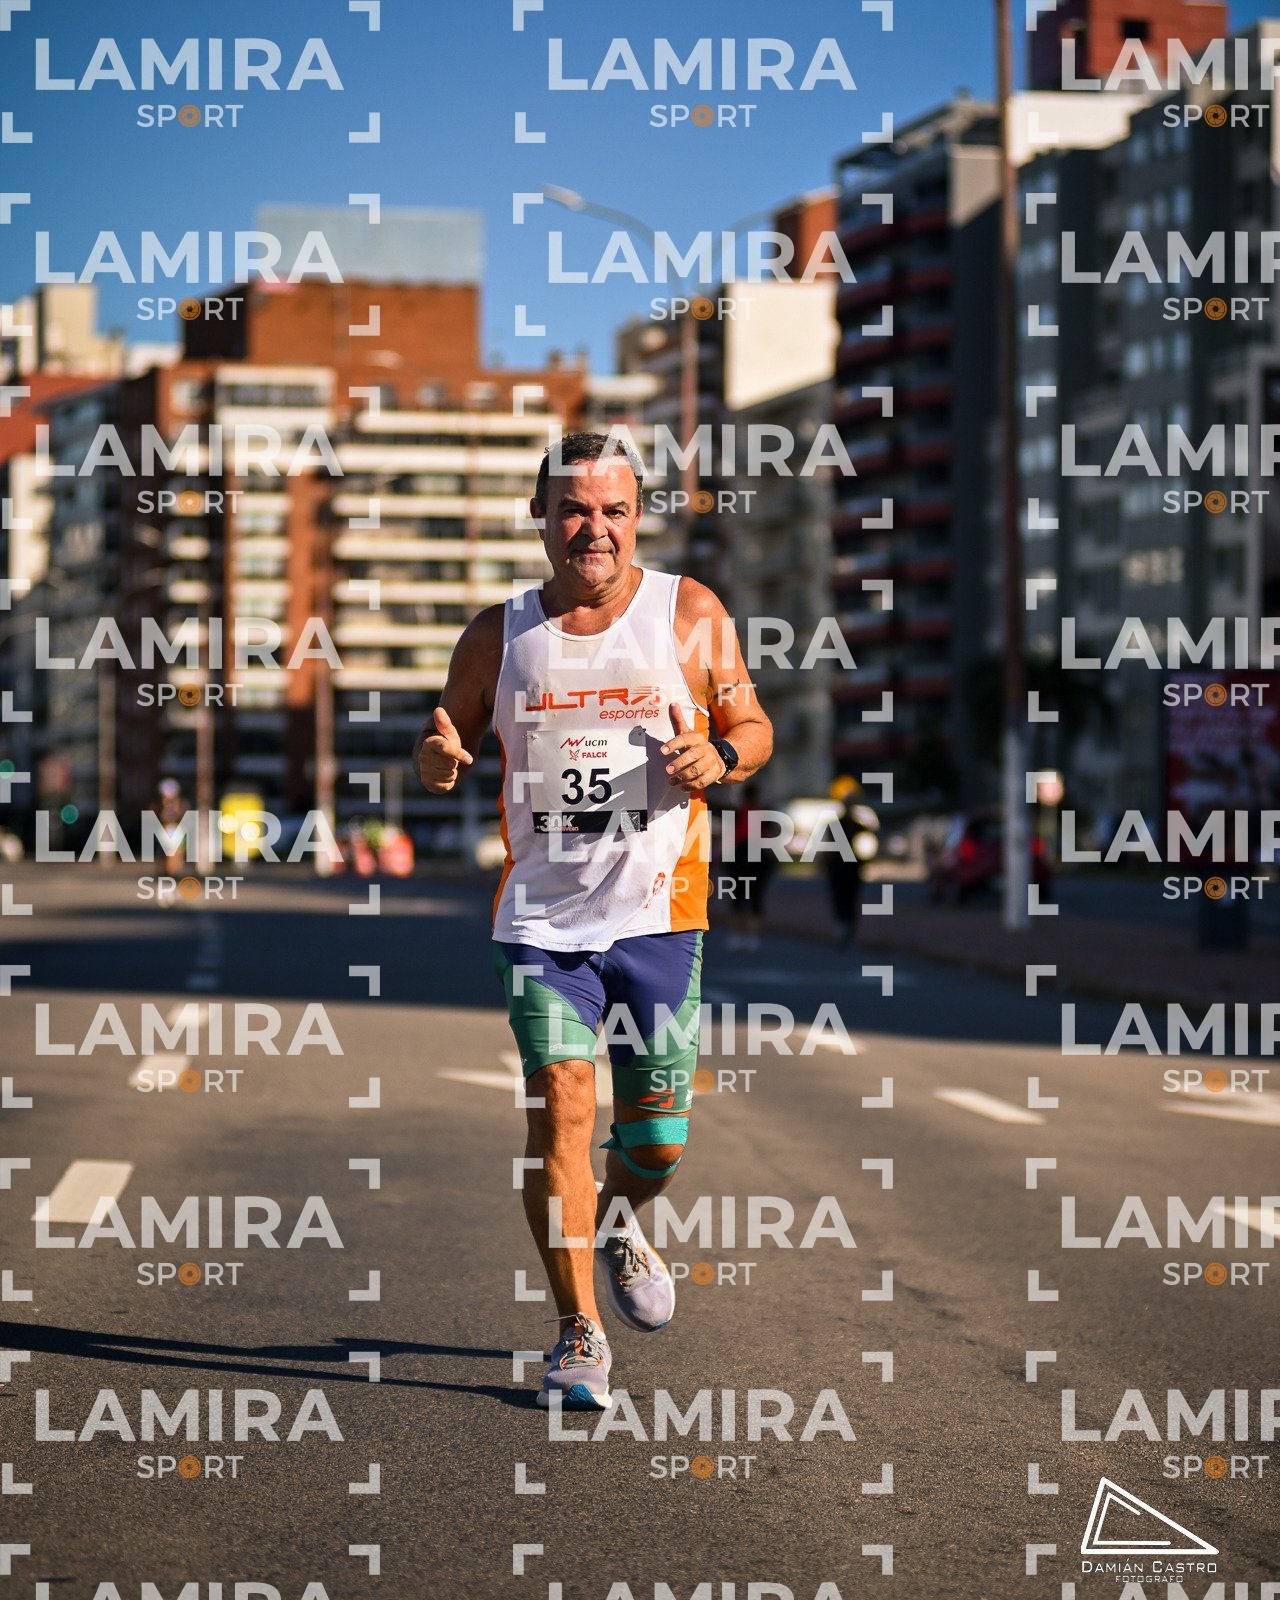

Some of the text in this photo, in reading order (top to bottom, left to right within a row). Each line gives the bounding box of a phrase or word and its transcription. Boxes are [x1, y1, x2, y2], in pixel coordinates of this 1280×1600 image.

[599, 707, 660, 722] esportes
[585, 739, 608, 747] ucm
[581, 751, 608, 759] FALCK
[561, 767, 612, 805] 35
[540, 815, 576, 832] 30K
